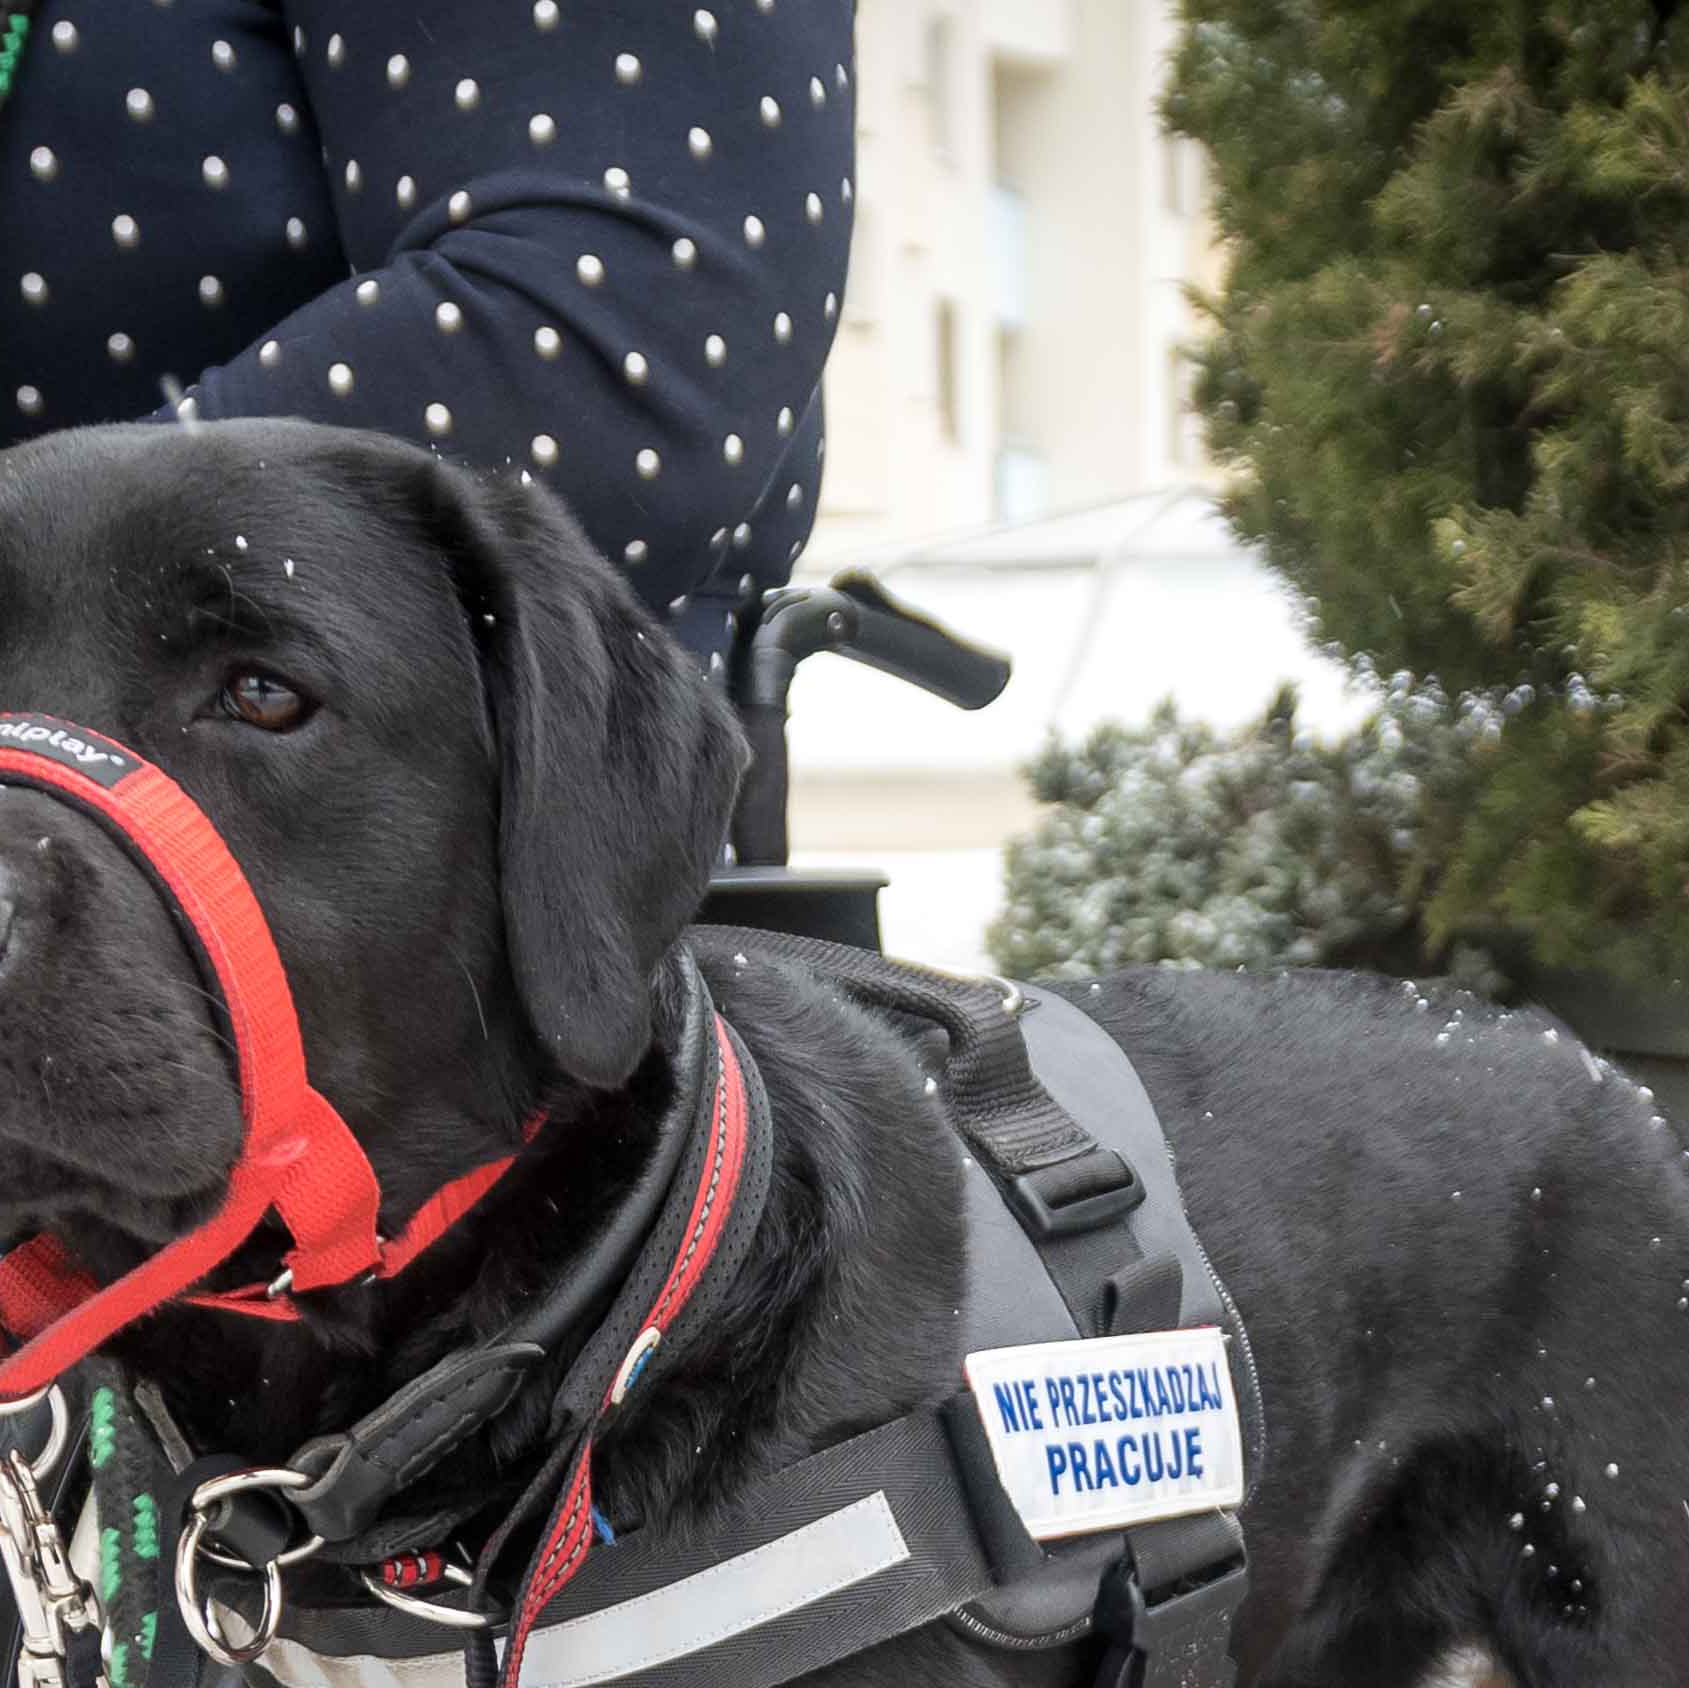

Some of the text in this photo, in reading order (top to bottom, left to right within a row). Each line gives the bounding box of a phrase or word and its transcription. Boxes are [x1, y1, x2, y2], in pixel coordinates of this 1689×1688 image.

[993, 1362, 1223, 1433] NIE PRZESZKADZAJ
[1045, 1427, 1204, 1496] PRACUJĘ
